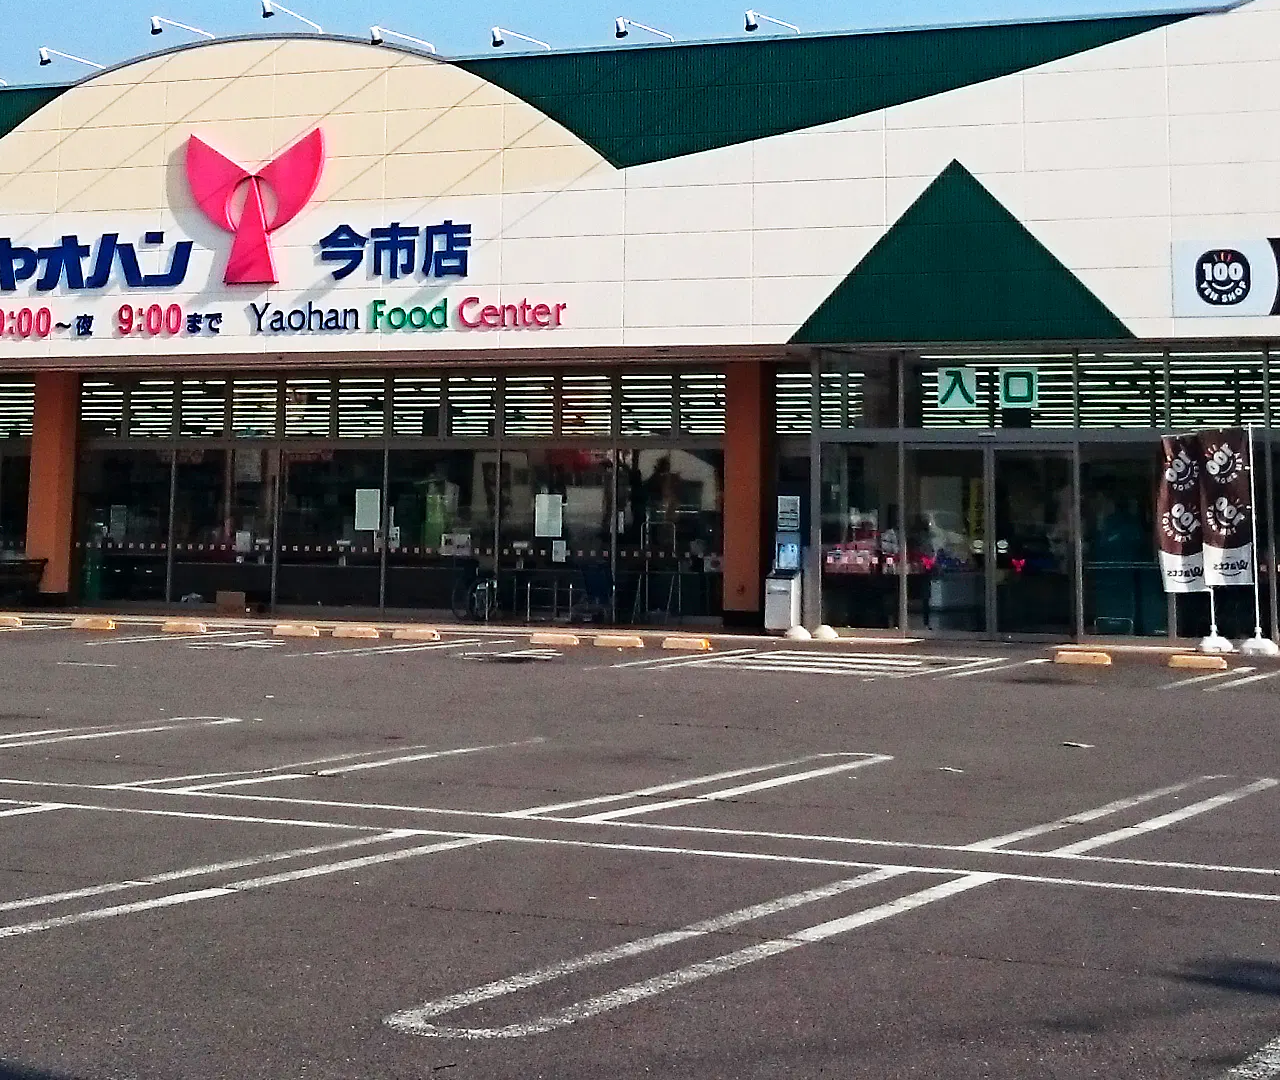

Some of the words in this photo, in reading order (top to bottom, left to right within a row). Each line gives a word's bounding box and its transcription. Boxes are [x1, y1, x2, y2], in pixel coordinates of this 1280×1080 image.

[320, 220, 471, 280] 今市店
[1202, 262, 1243, 281] 100
[1200, 281, 1219, 301] YEN
[1222, 281, 1247, 302] SHOP
[250, 301, 360, 331] Yaohan
[372, 298, 449, 329] Food
[458, 297, 567, 328] Center
[940, 370, 1034, 404] 入口
